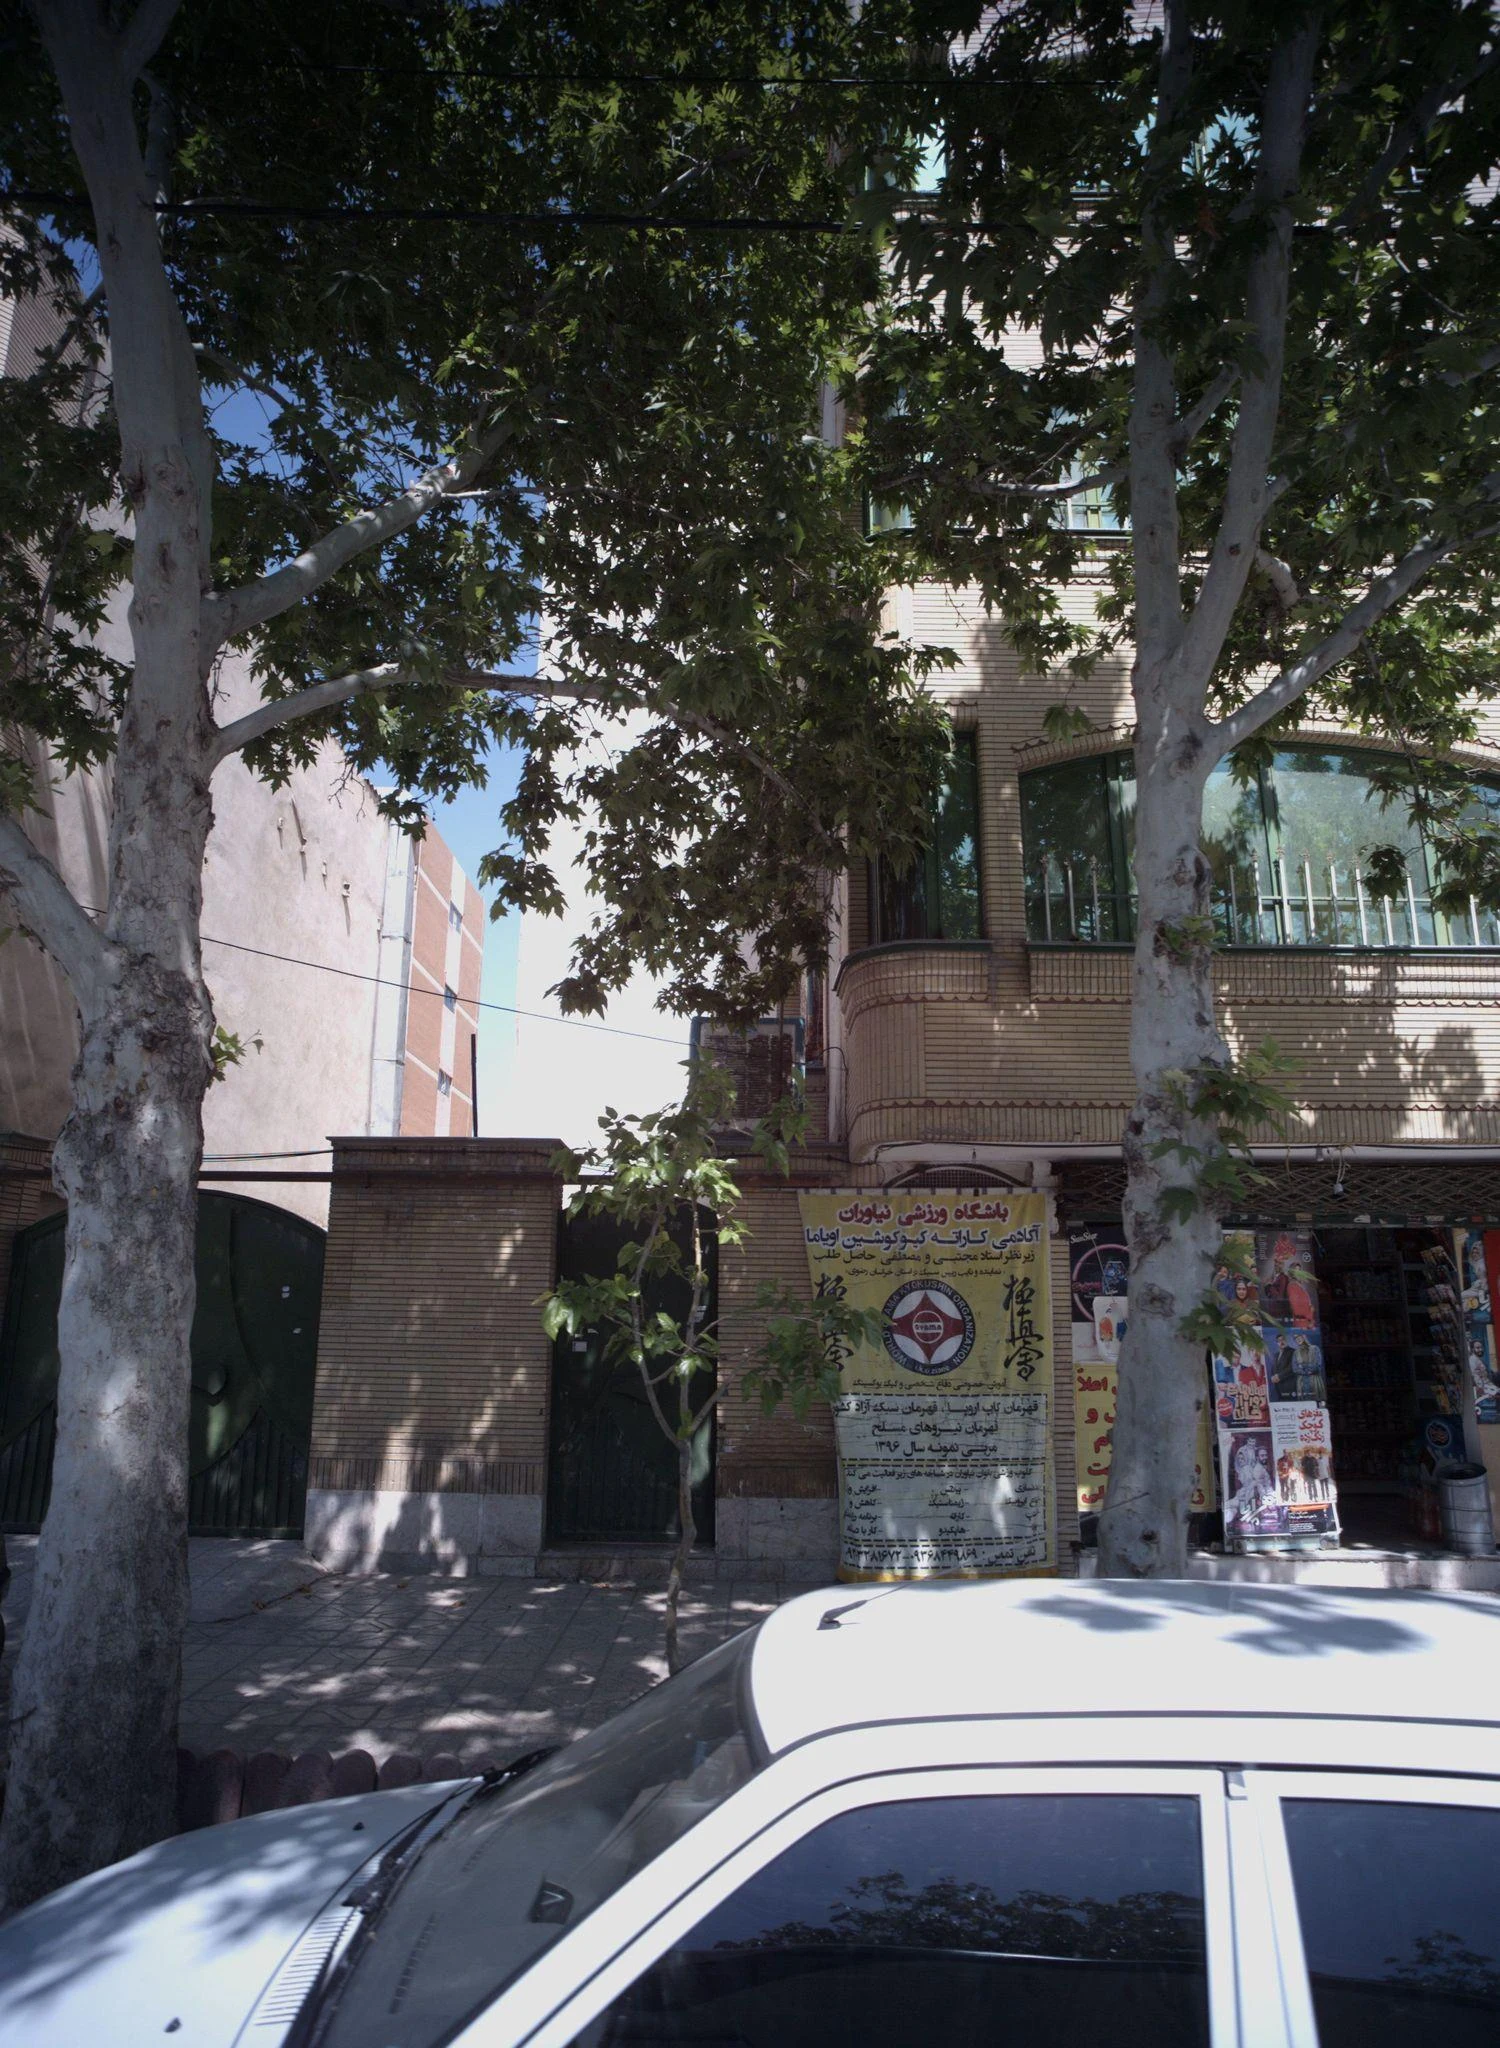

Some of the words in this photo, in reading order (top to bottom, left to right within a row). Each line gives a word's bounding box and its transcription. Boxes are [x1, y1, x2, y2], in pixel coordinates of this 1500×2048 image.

[838, 1202, 892, 1225] نیاوران
[897, 1203, 948, 1226] ورزشی
[954, 1202, 1009, 1222] باشگاه
[805, 1228, 840, 1247] اویاما
[841, 1229, 928, 1251] کیوکوشین
[930, 1229, 988, 1248] کاراته
[992, 1224, 1041, 1249] آکادمی
[812, 1248, 841, 1262] طلب
[842, 1249, 877, 1264] حاصل
[880, 1250, 921, 1266] مصطفی
[924, 1253, 931, 1264] و
[933, 1252, 978, 1265] مجتبی
[980, 1250, 1004, 1261] استاد
[1003, 1250, 1021, 1265] نظر
[1022, 1251, 1035, 1264] زیر
[853, 1399, 871, 1415] آزاد
[873, 1402, 899, 1414] سبک
[901, 1401, 938, 1417] قهرمان
[946, 1402, 979, 1418] اروپا
[1003, 1400, 1038, 1417] قهرمان
[870, 1421, 906, 1437] مسلح
[908, 1421, 961, 1438] نیروهای
[963, 1420, 998, 1437] قهرمان
[874, 1440, 899, 1454] ۱۳۹۶
[902, 1441, 925, 1458] سال
[926, 1442, 958, 1457] نمونه
[959, 1444, 998, 1458] مربی
[858, 1471, 870, 1480] می
[871, 1468, 895, 1479] فعالیت
[853, 1498, 877, 1510] کاهش
